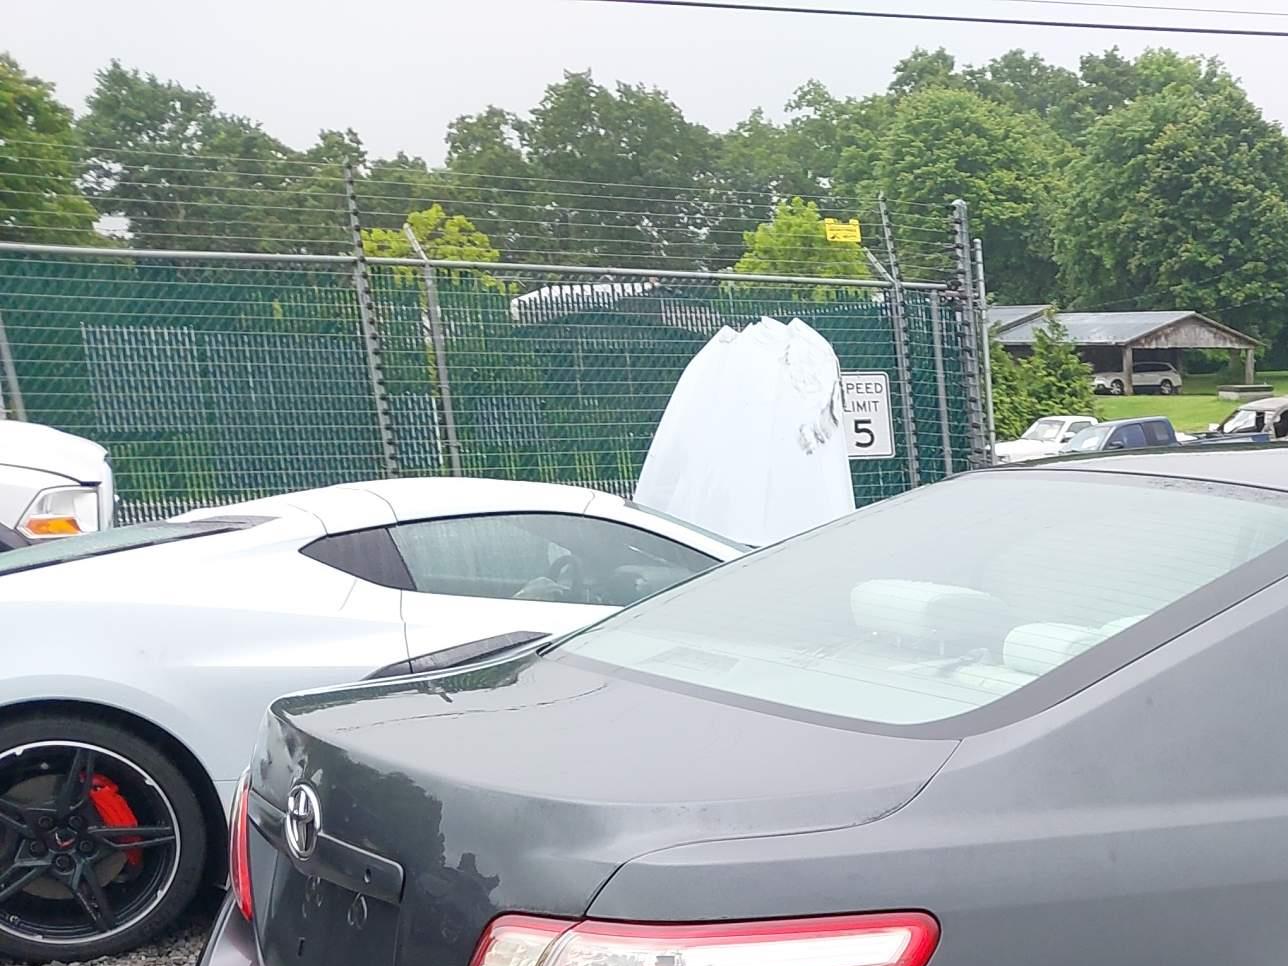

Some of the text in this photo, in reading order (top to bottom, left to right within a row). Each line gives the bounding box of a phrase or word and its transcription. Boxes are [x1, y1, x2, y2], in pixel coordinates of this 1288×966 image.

[846, 382, 883, 394] PEED
[844, 401, 879, 412] LIMIT
[854, 419, 875, 448] 5
